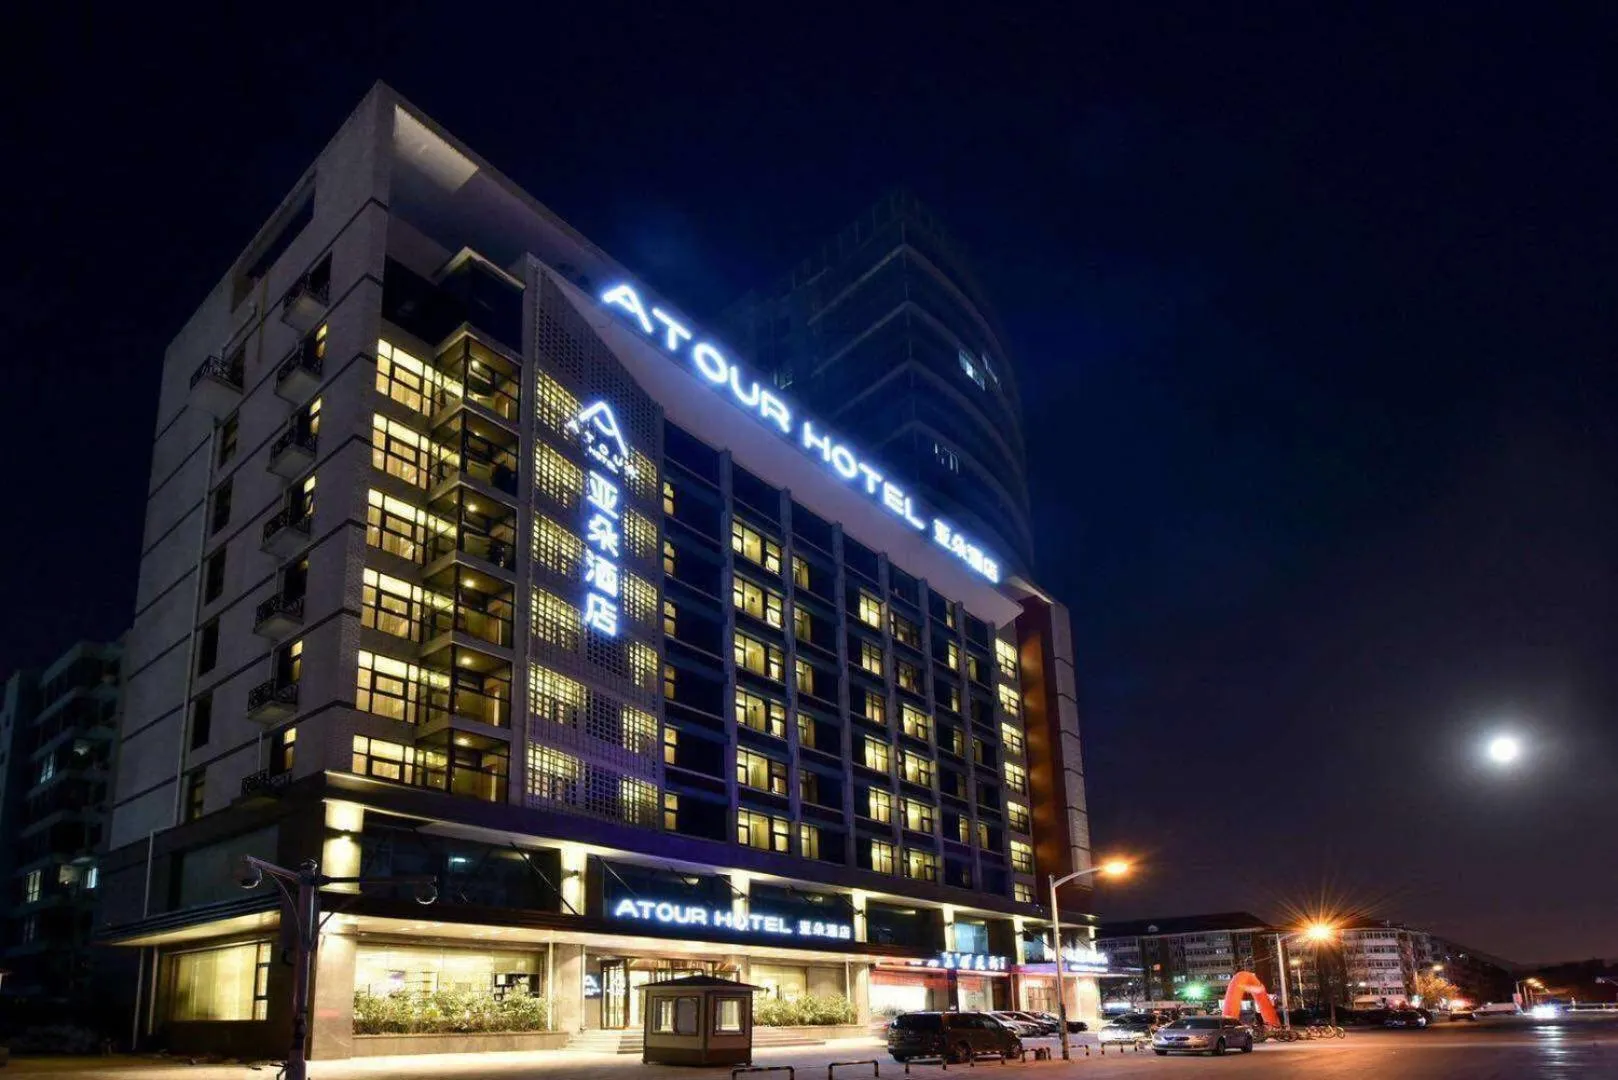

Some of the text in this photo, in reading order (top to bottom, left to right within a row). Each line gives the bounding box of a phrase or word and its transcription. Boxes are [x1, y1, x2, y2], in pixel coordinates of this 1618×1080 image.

[603, 284, 926, 530] ATOUR HOTEL
[585, 470, 619, 636] 亚朵酒店
[615, 899, 793, 934] ATOUR HOTEL
